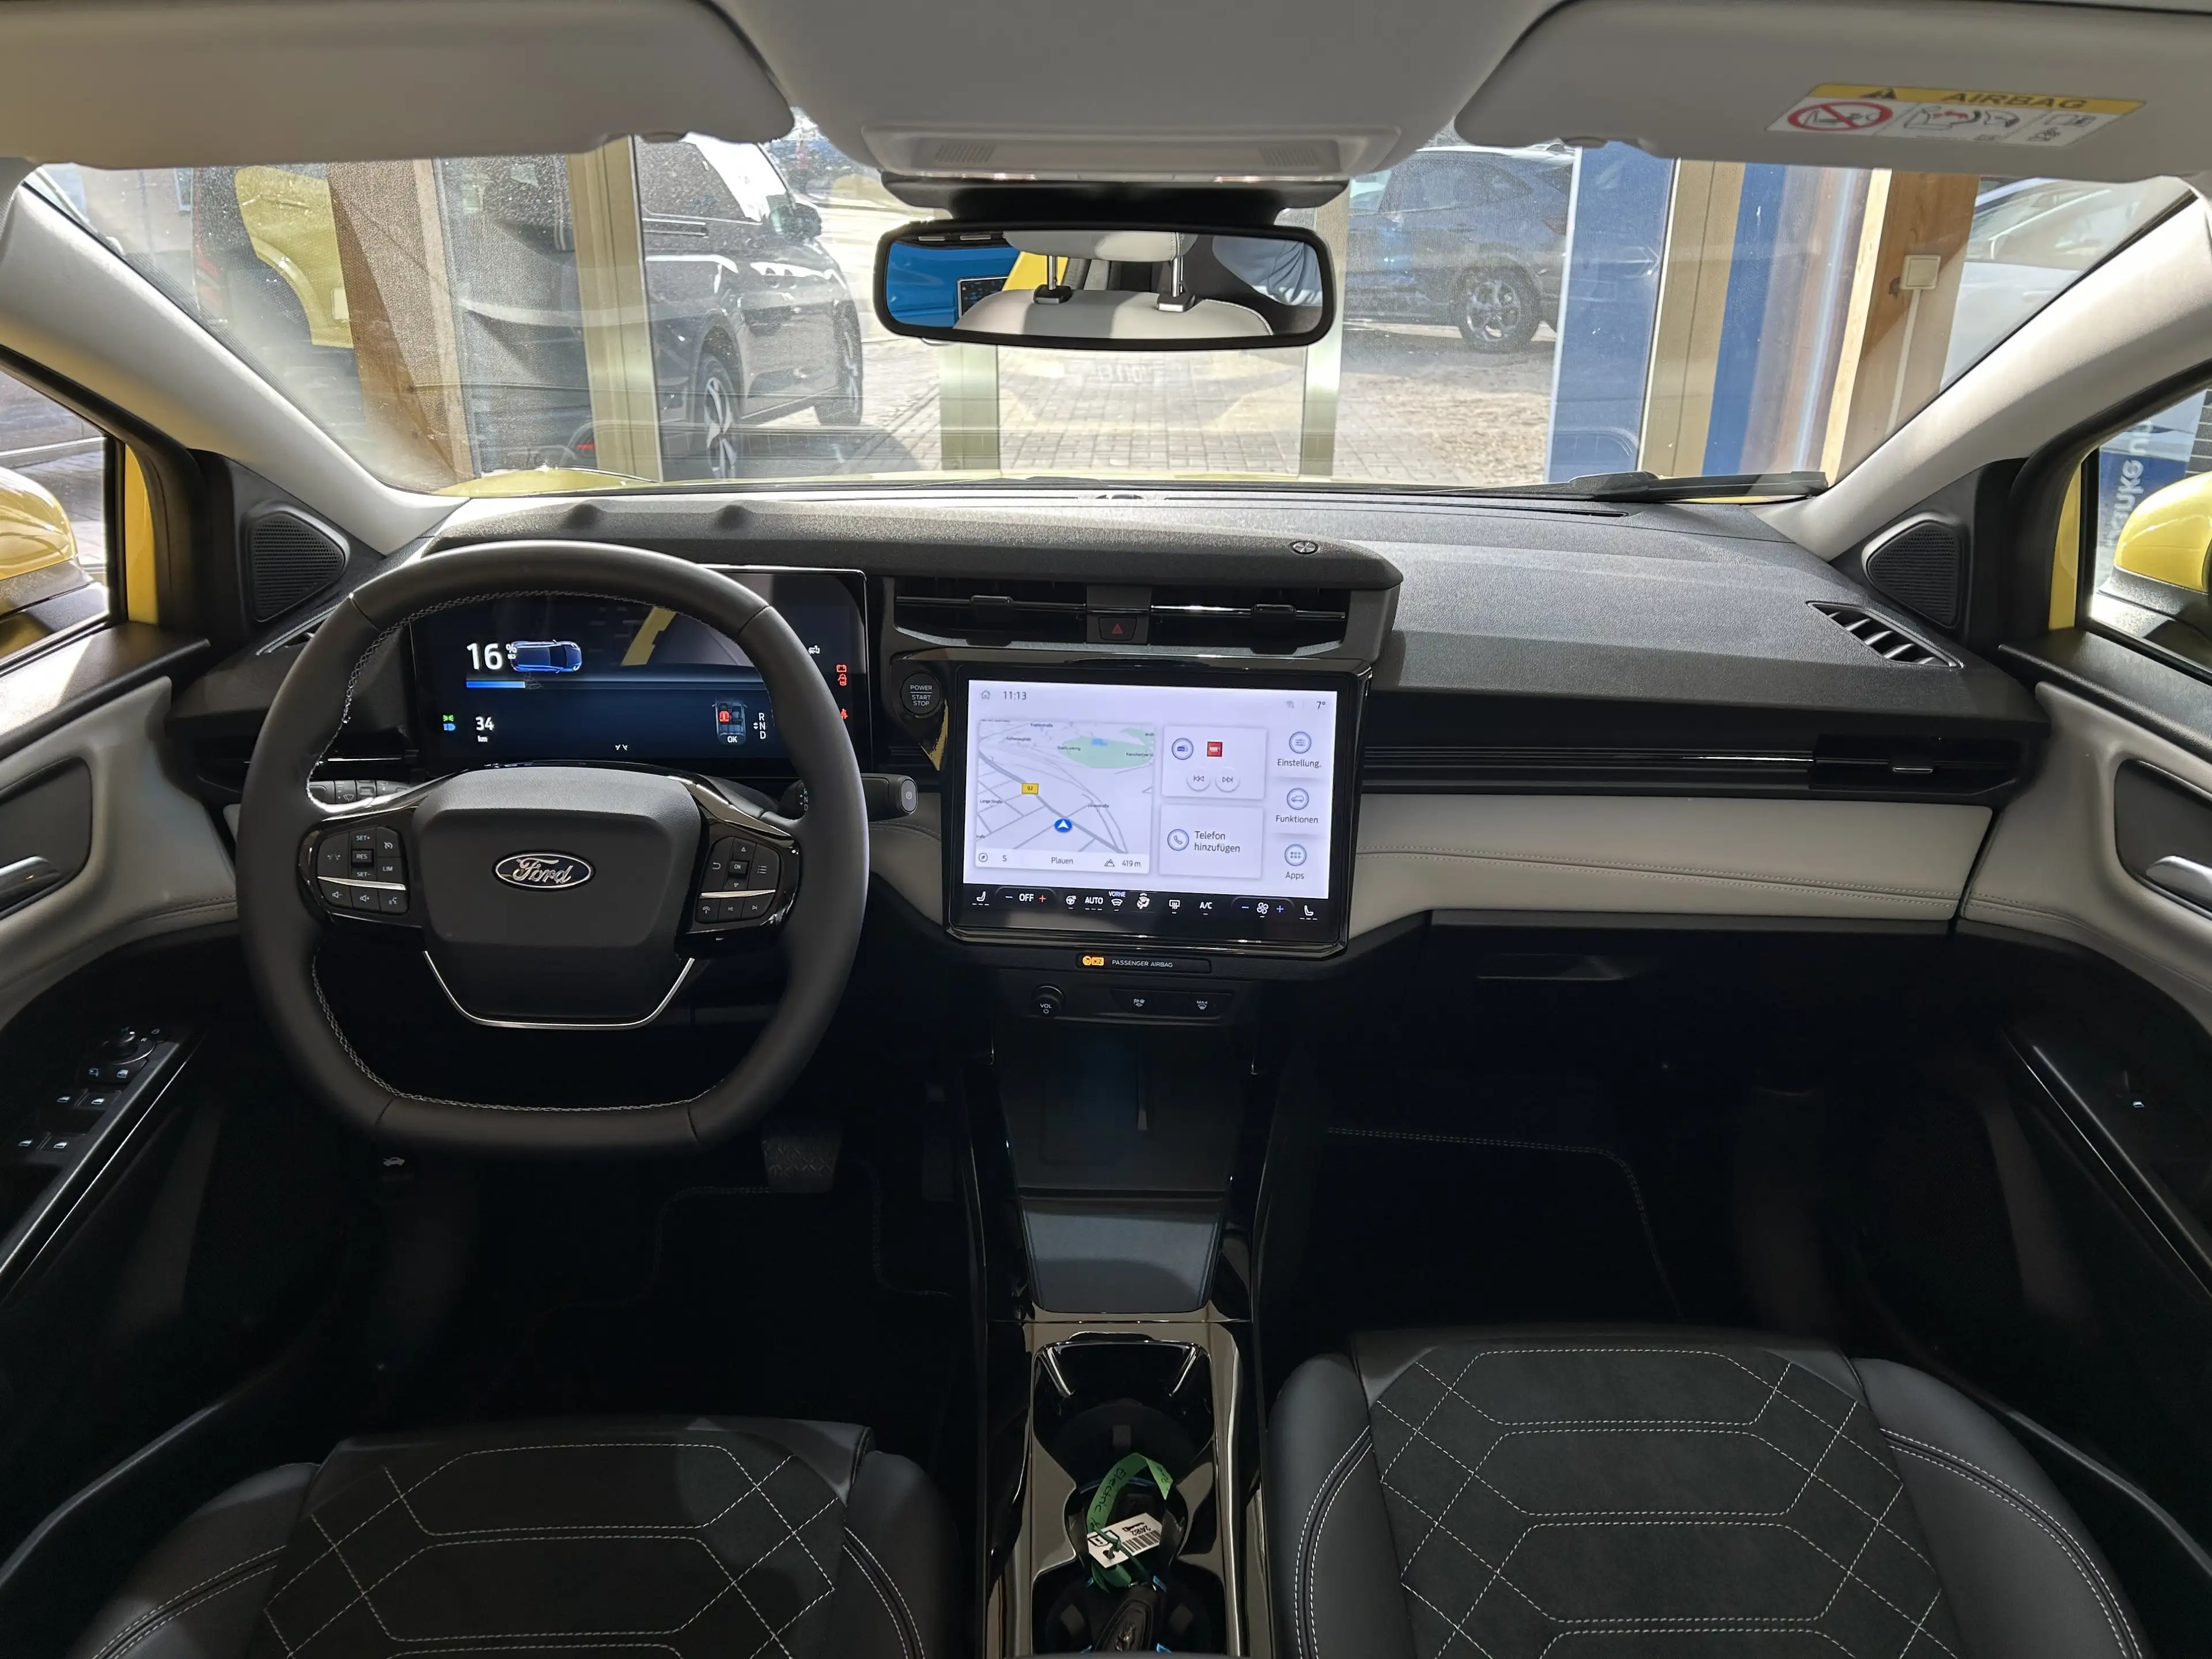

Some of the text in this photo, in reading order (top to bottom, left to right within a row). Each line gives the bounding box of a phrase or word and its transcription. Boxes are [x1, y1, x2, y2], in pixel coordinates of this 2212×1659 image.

[1941, 92, 2088, 109] AIRBAG
[1002, 691, 1027, 701] 11:13
[759, 713, 765, 721] R
[475, 717, 495, 731] 34
[759, 722, 766, 730] N
[477, 735, 488, 743] km
[760, 731, 767, 740] D
[1275, 815, 1319, 824] Funktionen
[1194, 831, 1226, 840] Telefon
[1194, 843, 1241, 855] hinzufügen
[1051, 857, 1074, 865] Plauen
[512, 857, 572, 885] Ford
[1285, 871, 1305, 881] Apps
[1018, 892, 1035, 903] OFF
[1085, 896, 1104, 906] AUTO
[1199, 901, 1213, 910] A/C
[1094, 1468, 1126, 1513] Electric
